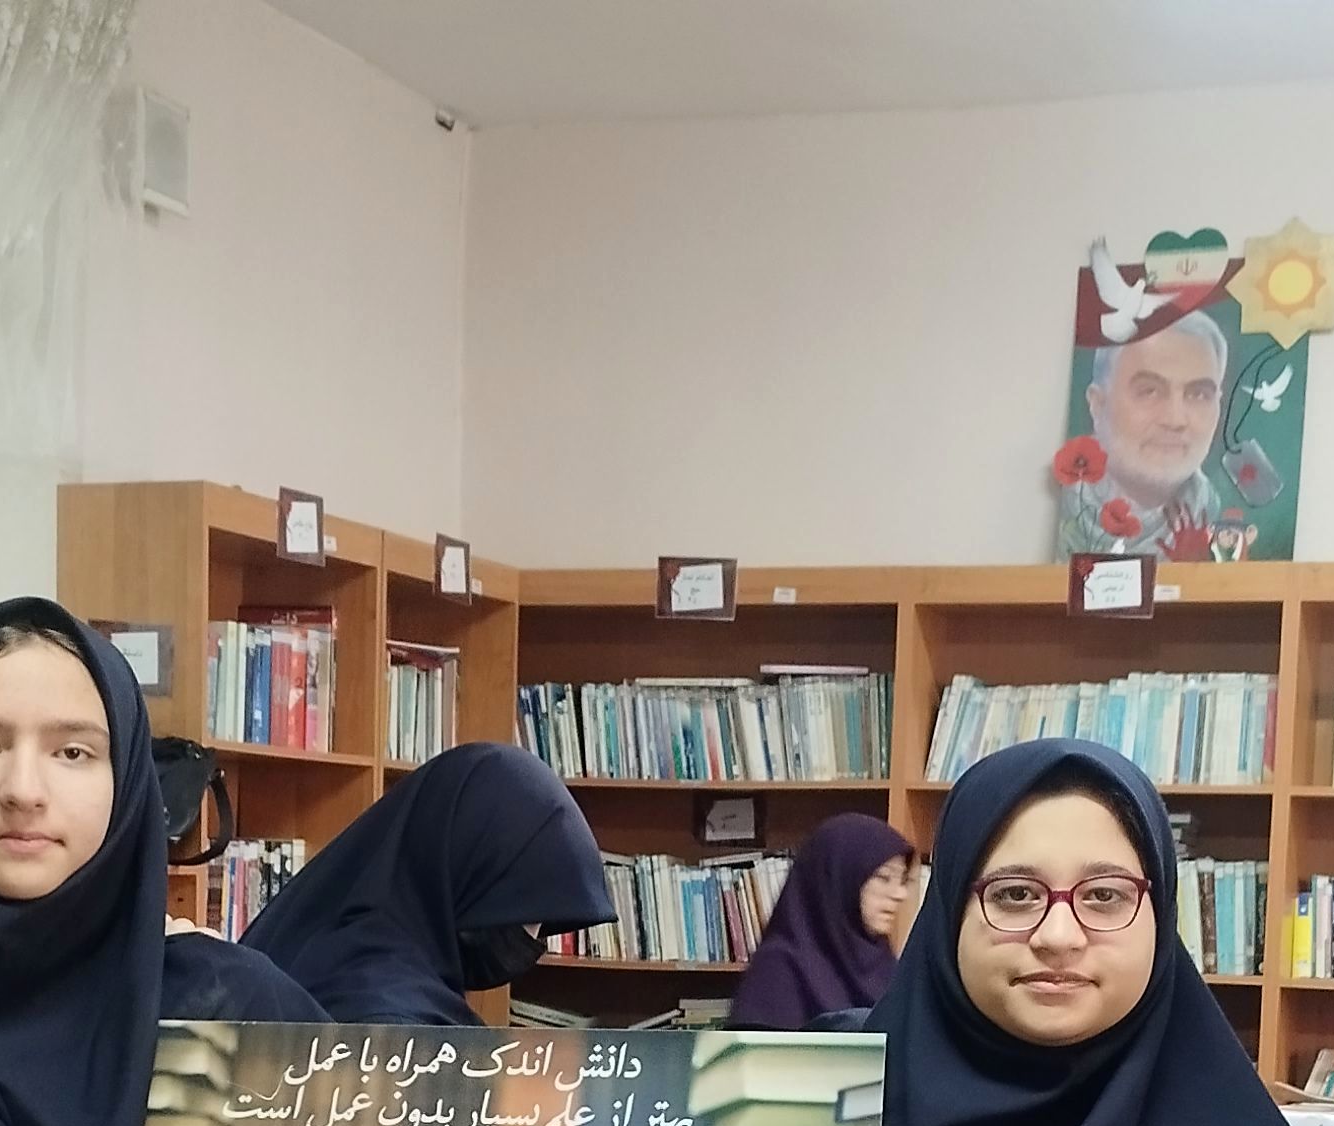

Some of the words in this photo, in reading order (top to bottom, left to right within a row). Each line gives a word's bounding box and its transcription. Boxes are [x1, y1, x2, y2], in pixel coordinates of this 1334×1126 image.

[284, 1037, 353, 1085] عمل
[360, 1036, 378, 1083] با
[386, 1037, 457, 1087] همراه
[461, 1041, 554, 1078] اندک
[554, 1041, 642, 1092] دانش
[221, 1085, 304, 1121] است
